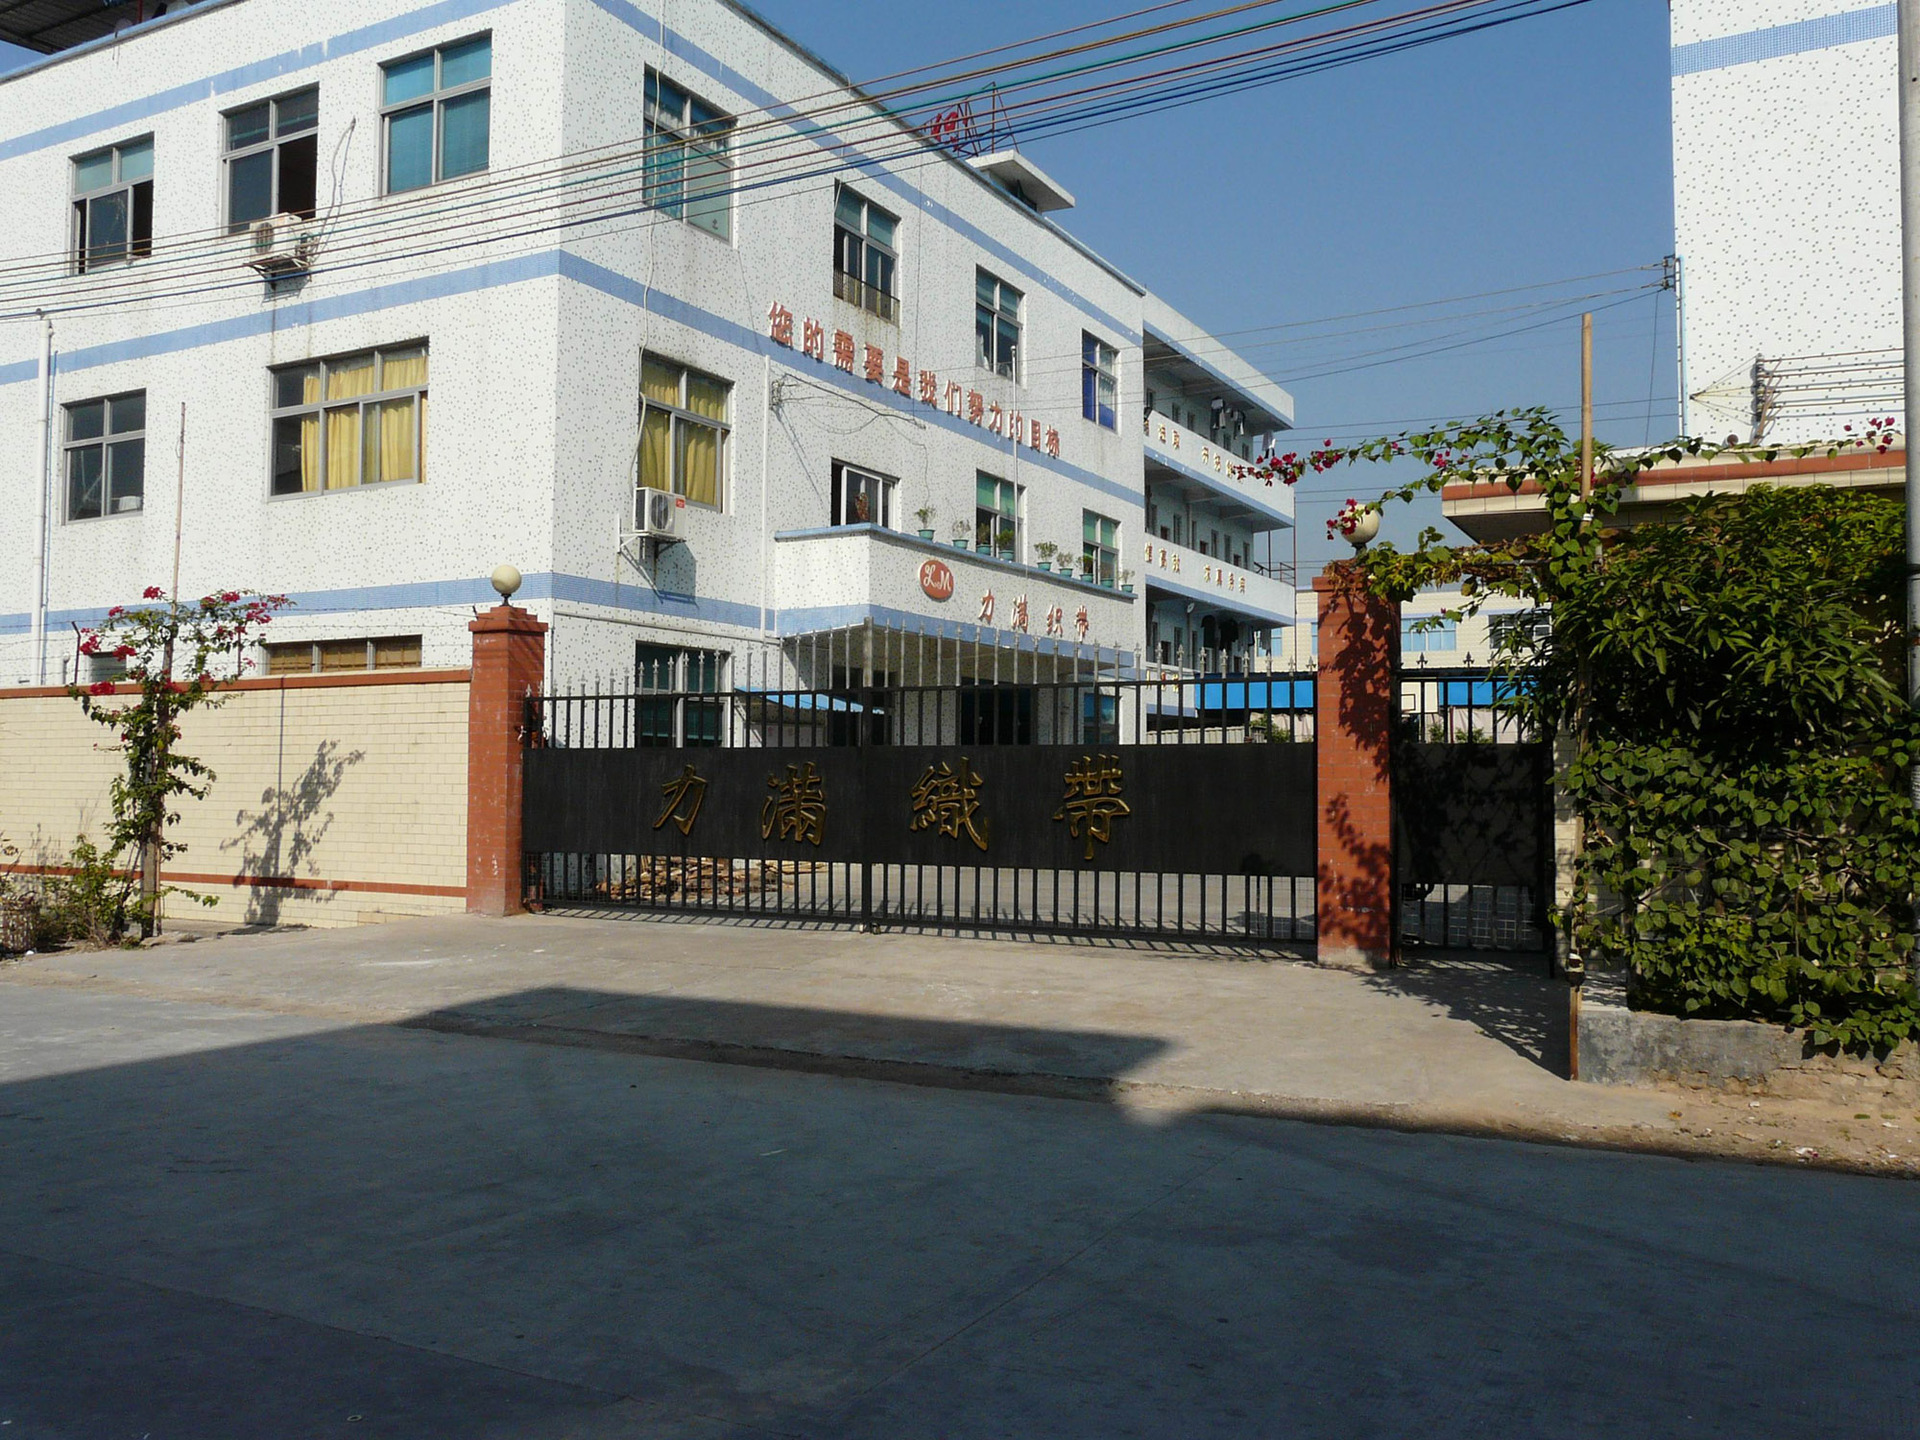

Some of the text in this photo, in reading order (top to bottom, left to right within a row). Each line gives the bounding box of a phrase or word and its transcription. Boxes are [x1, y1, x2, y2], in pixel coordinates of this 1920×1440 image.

[768, 300, 1061, 459] 您的需要是我们努力的目标
